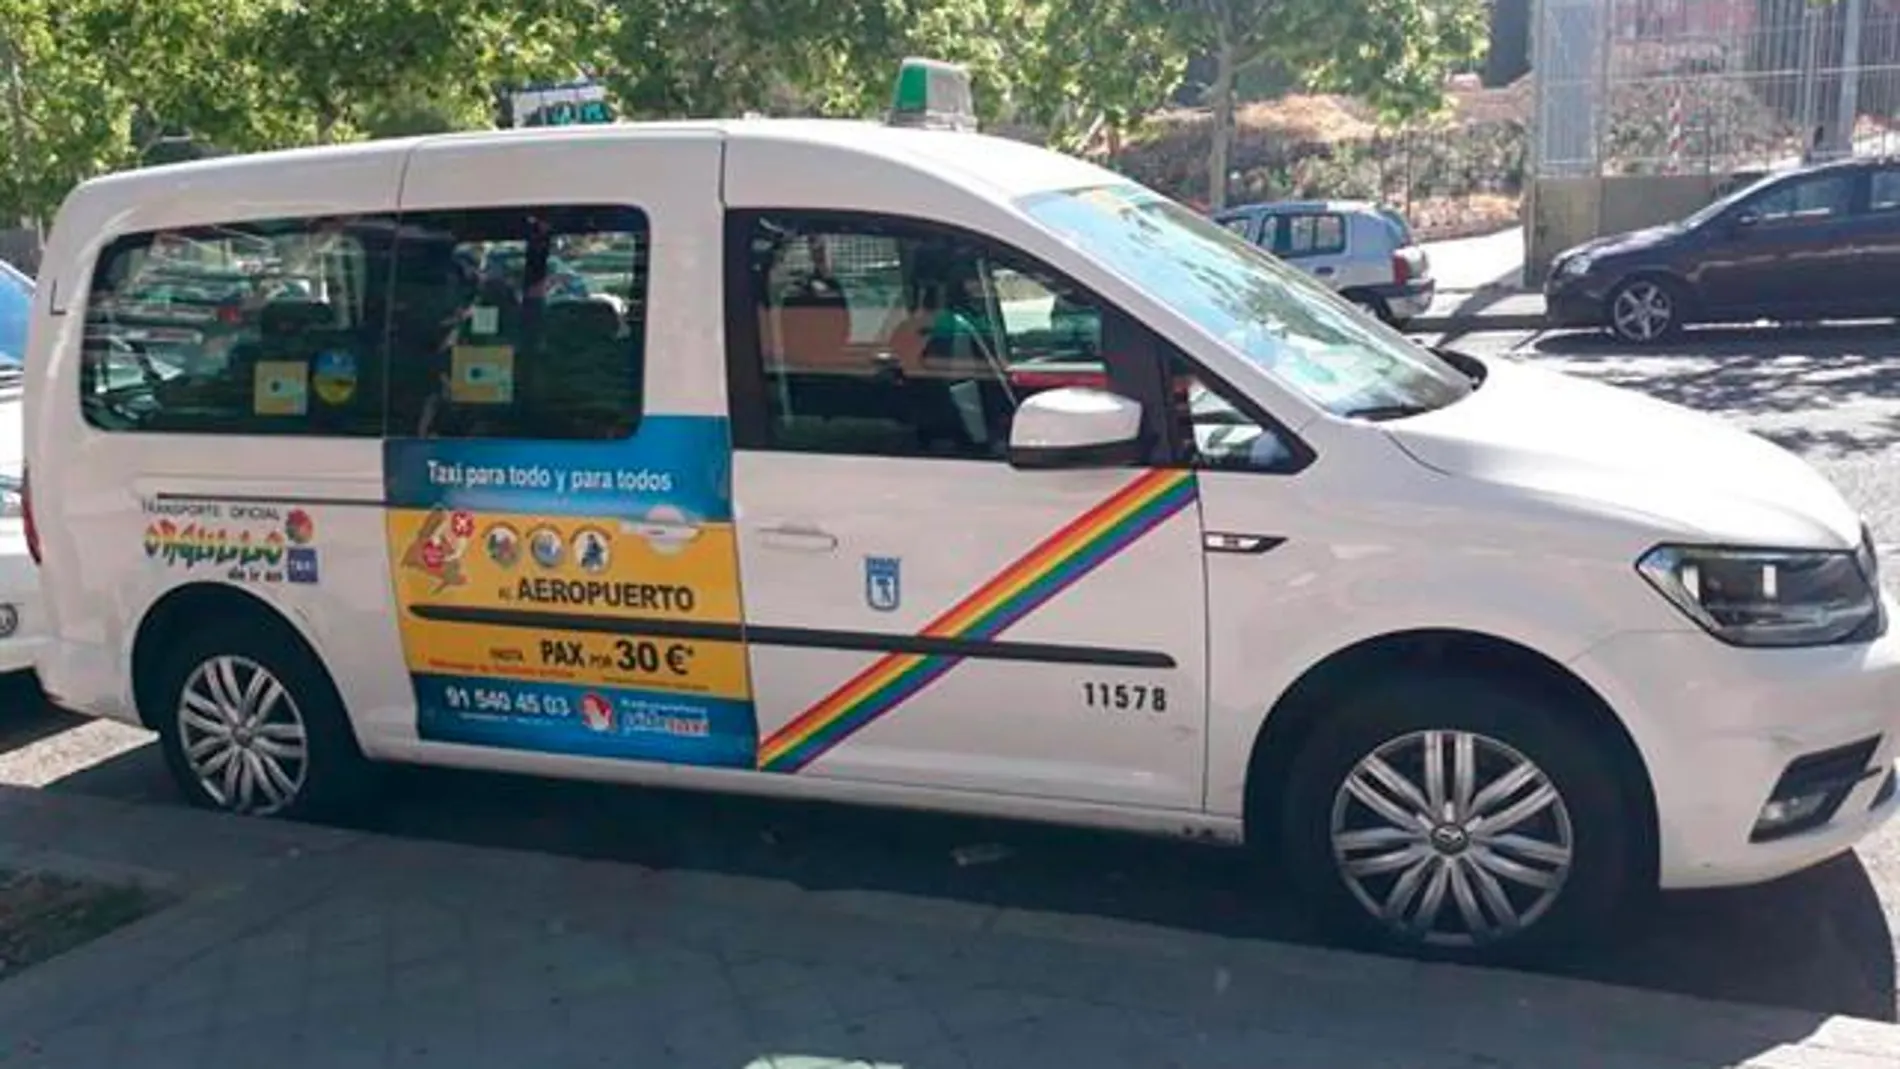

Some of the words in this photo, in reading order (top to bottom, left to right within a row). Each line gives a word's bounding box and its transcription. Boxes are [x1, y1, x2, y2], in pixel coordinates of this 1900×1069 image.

[428, 460, 463, 484] Taxi
[465, 465, 505, 489] para
[509, 465, 550, 488] todo
[555, 470, 566, 494] y
[570, 470, 613, 493] para
[617, 469, 673, 493] todos
[518, 577, 695, 612] AEROPUERTO
[540, 639, 586, 669] PAX
[615, 639, 660, 674] 30
[1083, 682, 1167, 713] 11578
